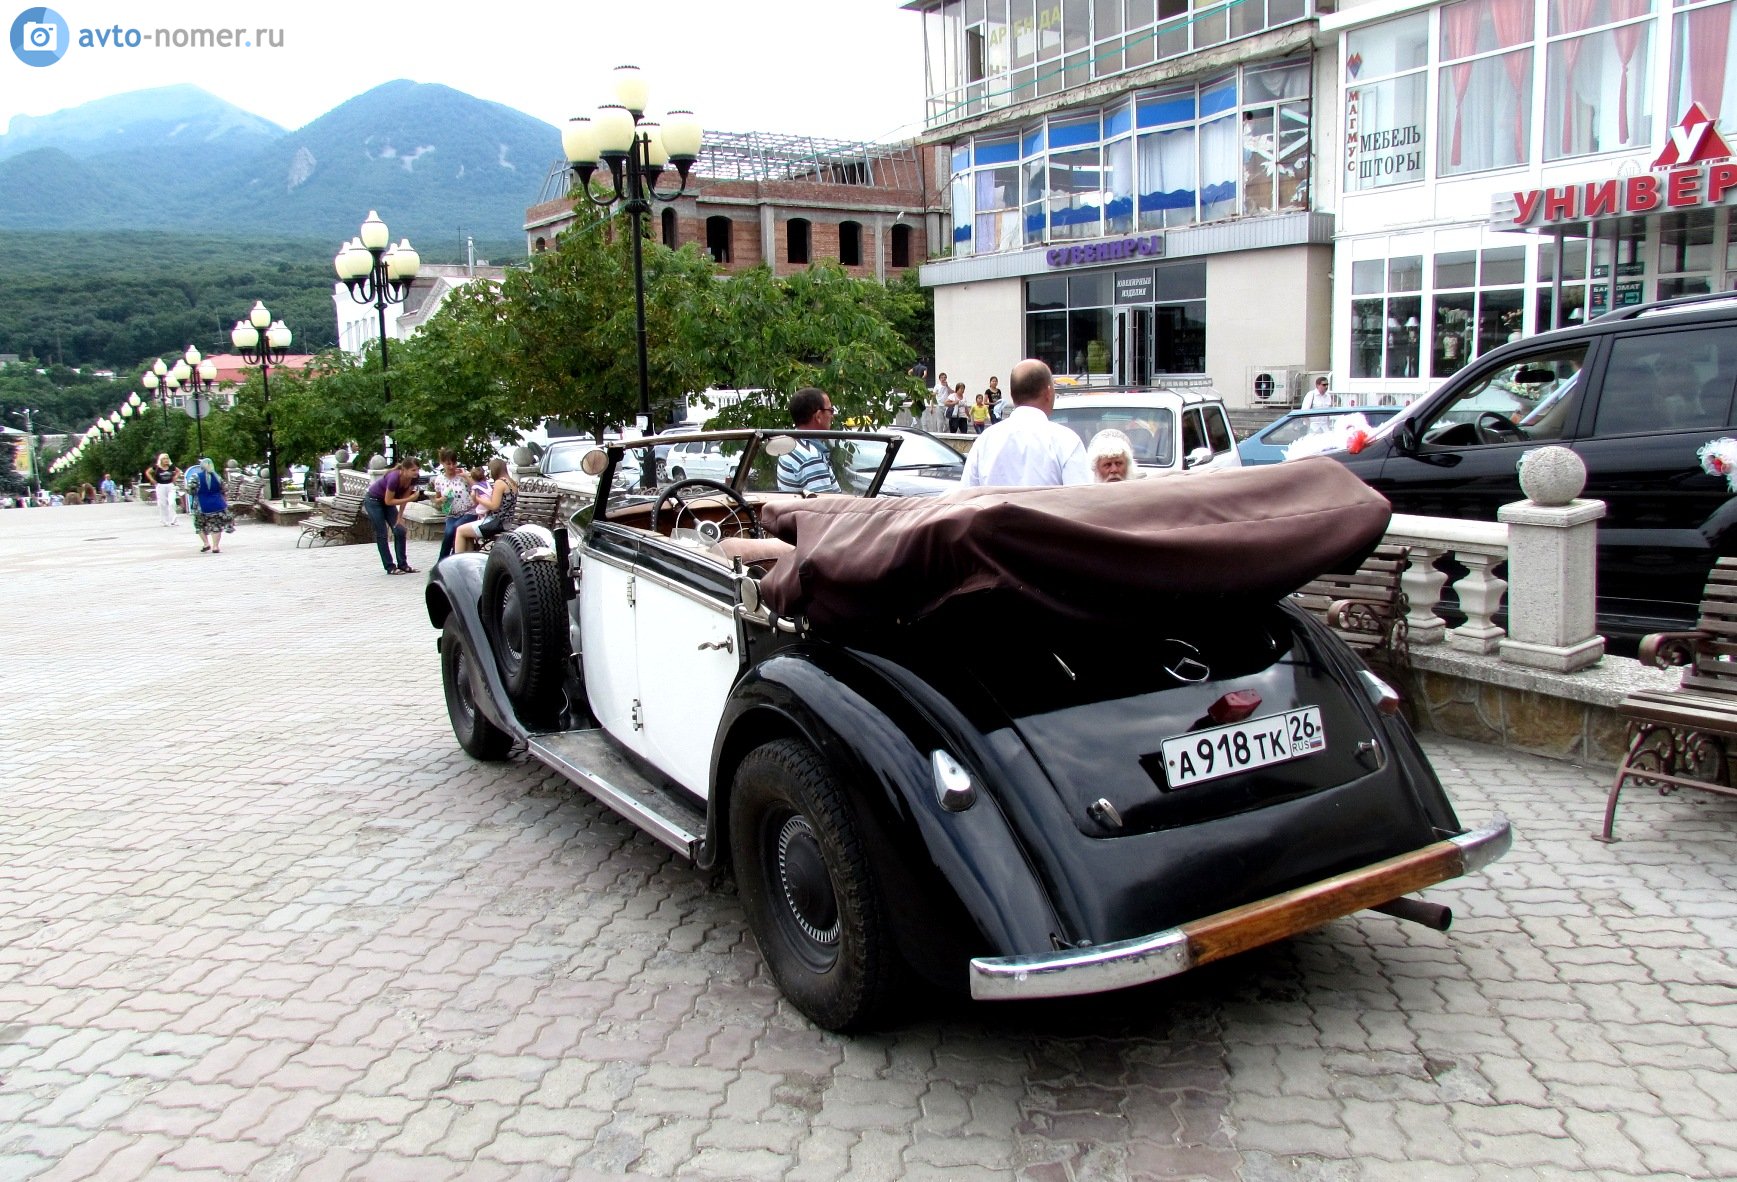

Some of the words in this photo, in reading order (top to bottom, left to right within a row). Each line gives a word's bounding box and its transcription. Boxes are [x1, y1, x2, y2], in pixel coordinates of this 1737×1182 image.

[989, 5, 1062, 47] АРЕНДА
[1347, 91, 1360, 171] МАГМУС
[1360, 125, 1421, 153] МЕБЕЛЬ
[1359, 151, 1421, 178] ШТОРЫ
[1046, 235, 1161, 266] СУВЕНИРЫ
[1117, 277, 1152, 288] ЮВЕЛИРНЫЕ
[1121, 287, 1147, 298] ИЗДЕЛИЯ
[1593, 284, 1640, 292] БАНОМАТ
[1180, 729, 1286, 779] А918ТК
[1290, 713, 1314, 741] 26
[1292, 742, 1310, 753] RUS
